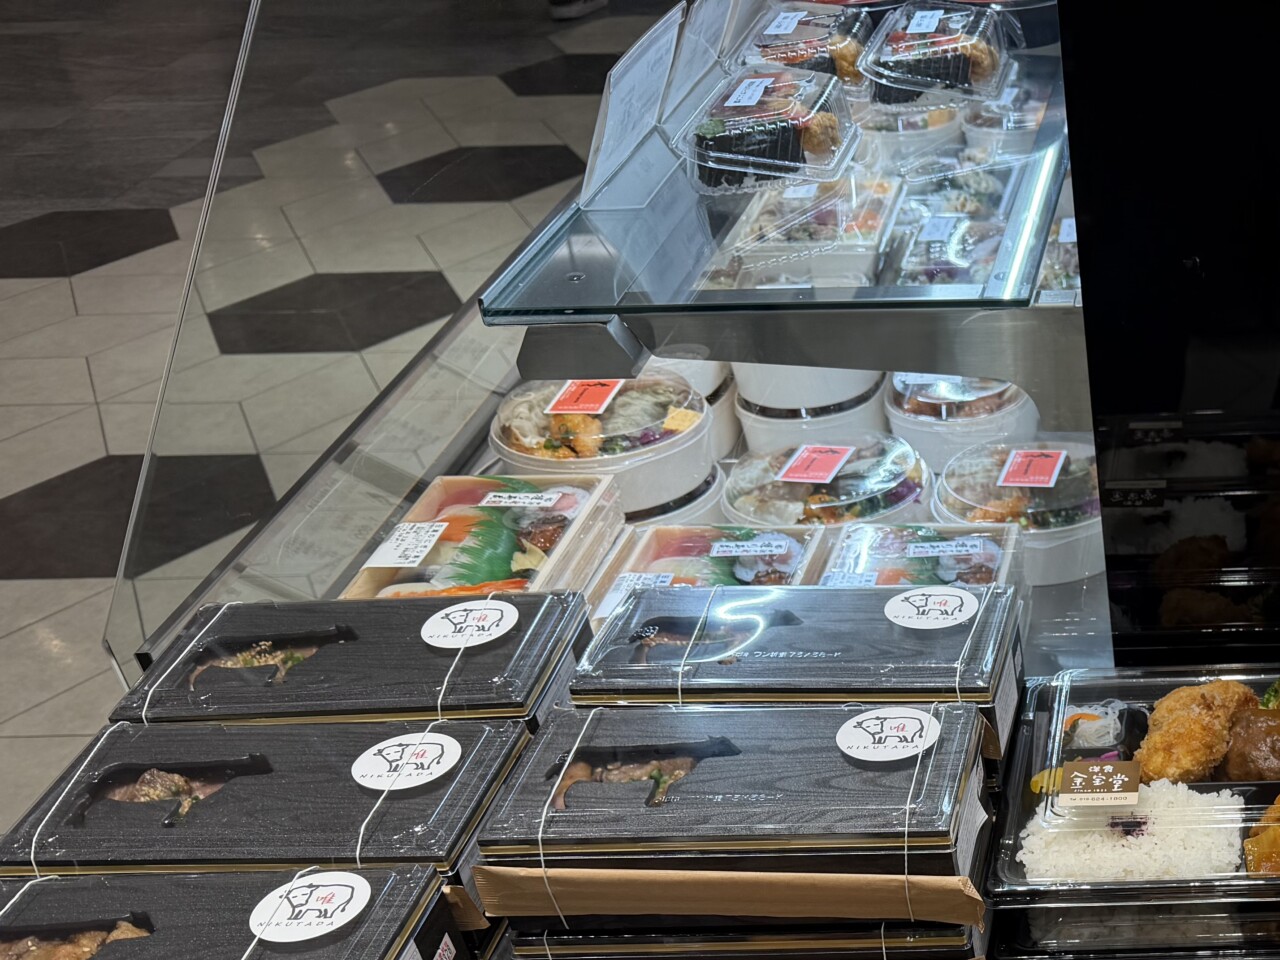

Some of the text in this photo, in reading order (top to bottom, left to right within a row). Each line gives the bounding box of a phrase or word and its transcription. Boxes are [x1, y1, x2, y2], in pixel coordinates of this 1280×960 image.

[892, 614, 958, 622] NIKUTADA
[846, 743, 919, 751] NIKUTADA
[360, 771, 434, 779] NIKUTADA
[1070, 771, 1129, 792] 金宝堂
[257, 920, 335, 928] NIKUTADA
